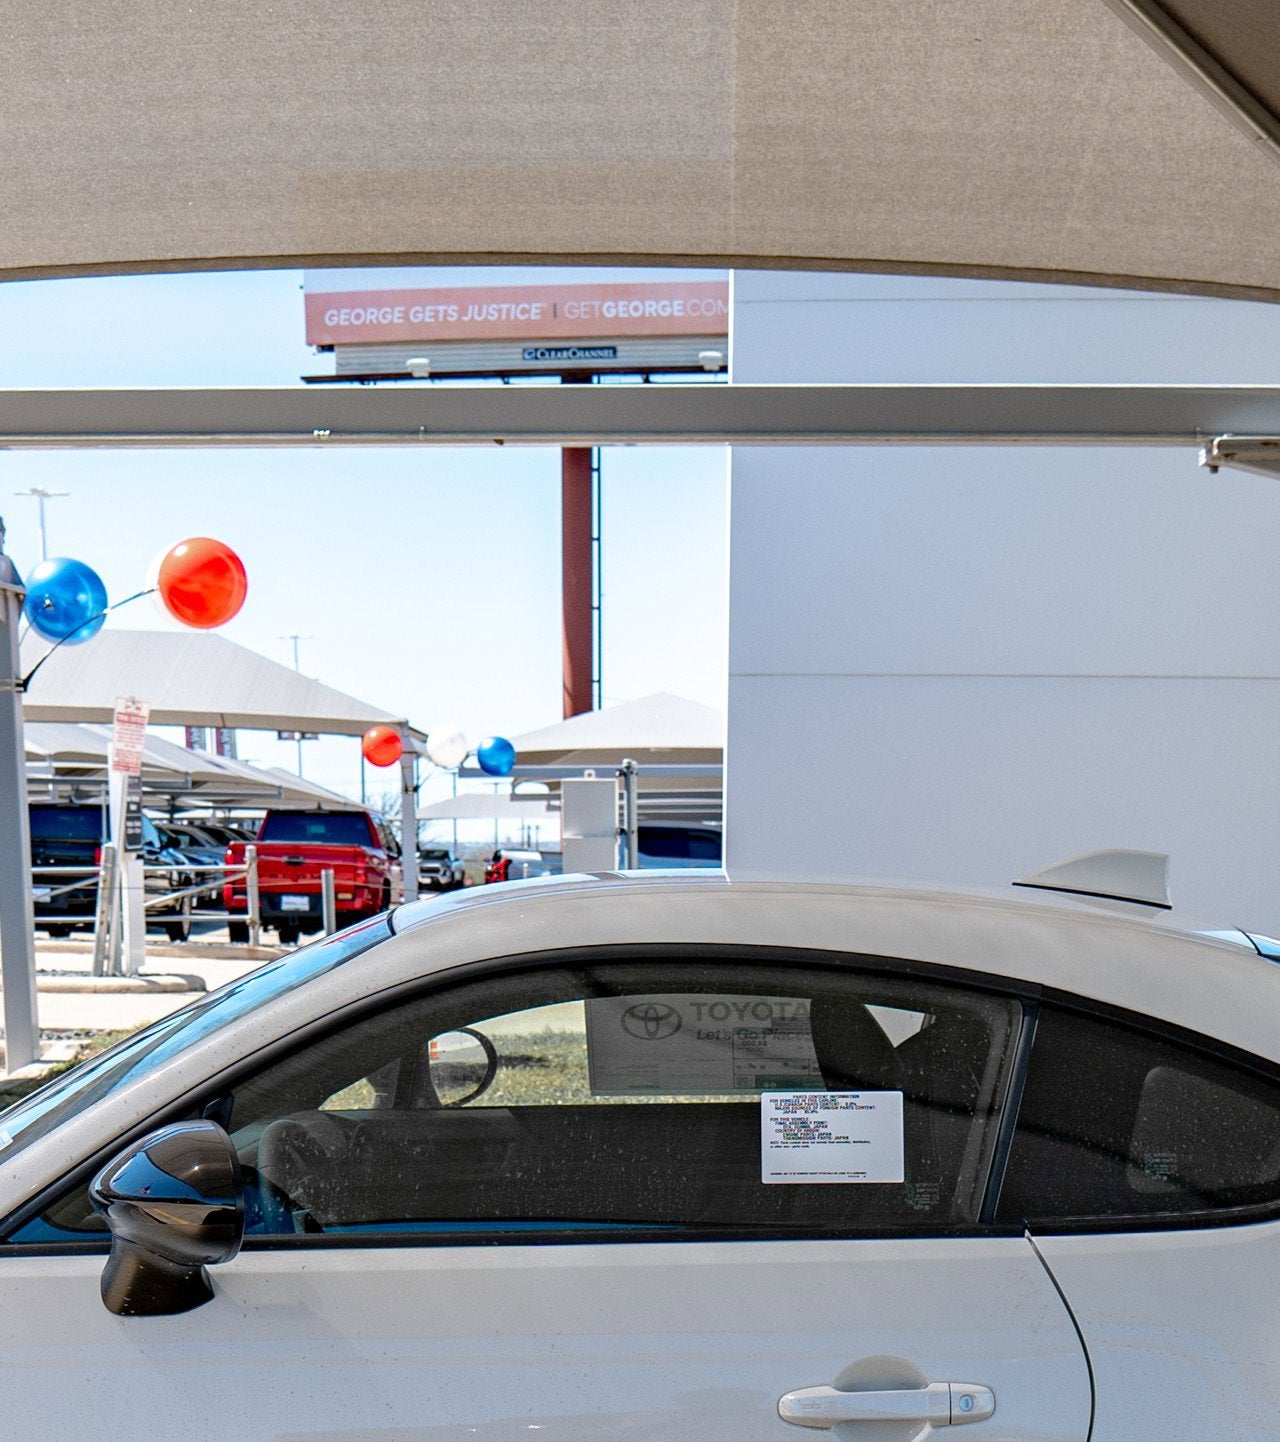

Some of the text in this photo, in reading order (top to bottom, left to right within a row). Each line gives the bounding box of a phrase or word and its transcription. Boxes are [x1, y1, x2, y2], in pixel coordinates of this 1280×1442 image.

[324, 306, 404, 326] GEORGE
[409, 304, 459, 323] GETS
[688, 1001, 811, 1022] TOYOTA
